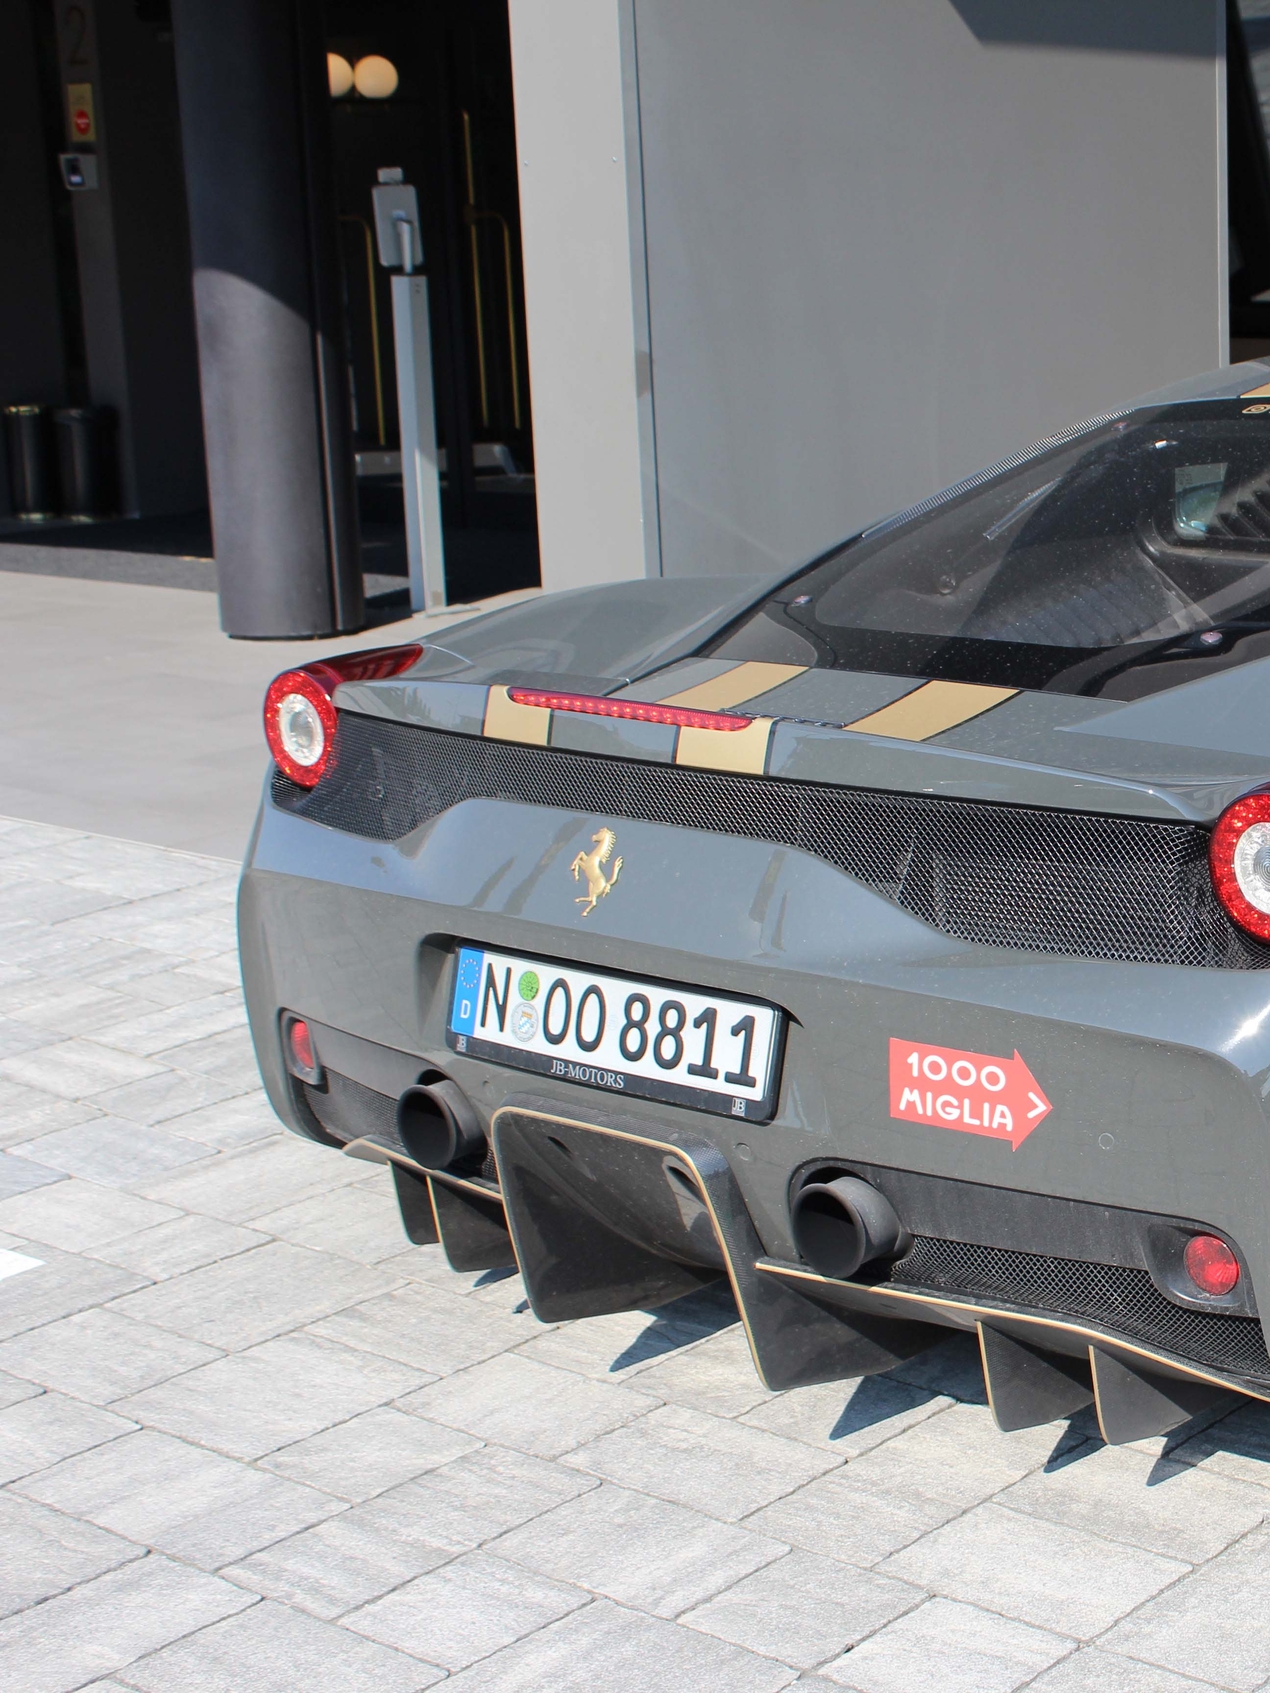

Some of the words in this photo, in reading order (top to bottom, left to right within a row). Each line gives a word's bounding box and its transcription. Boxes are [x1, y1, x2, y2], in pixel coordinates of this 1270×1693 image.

[65, 5, 89, 66] 2
[460, 999, 471, 1019] D
[480, 962, 512, 1033] N
[619, 992, 757, 1088] 8811
[551, 1059, 625, 1089] JB-MOTORS
[906, 1052, 1006, 1091] 1000
[732, 1098, 745, 1112] JB
[899, 1087, 1013, 1131] MIGLIA
